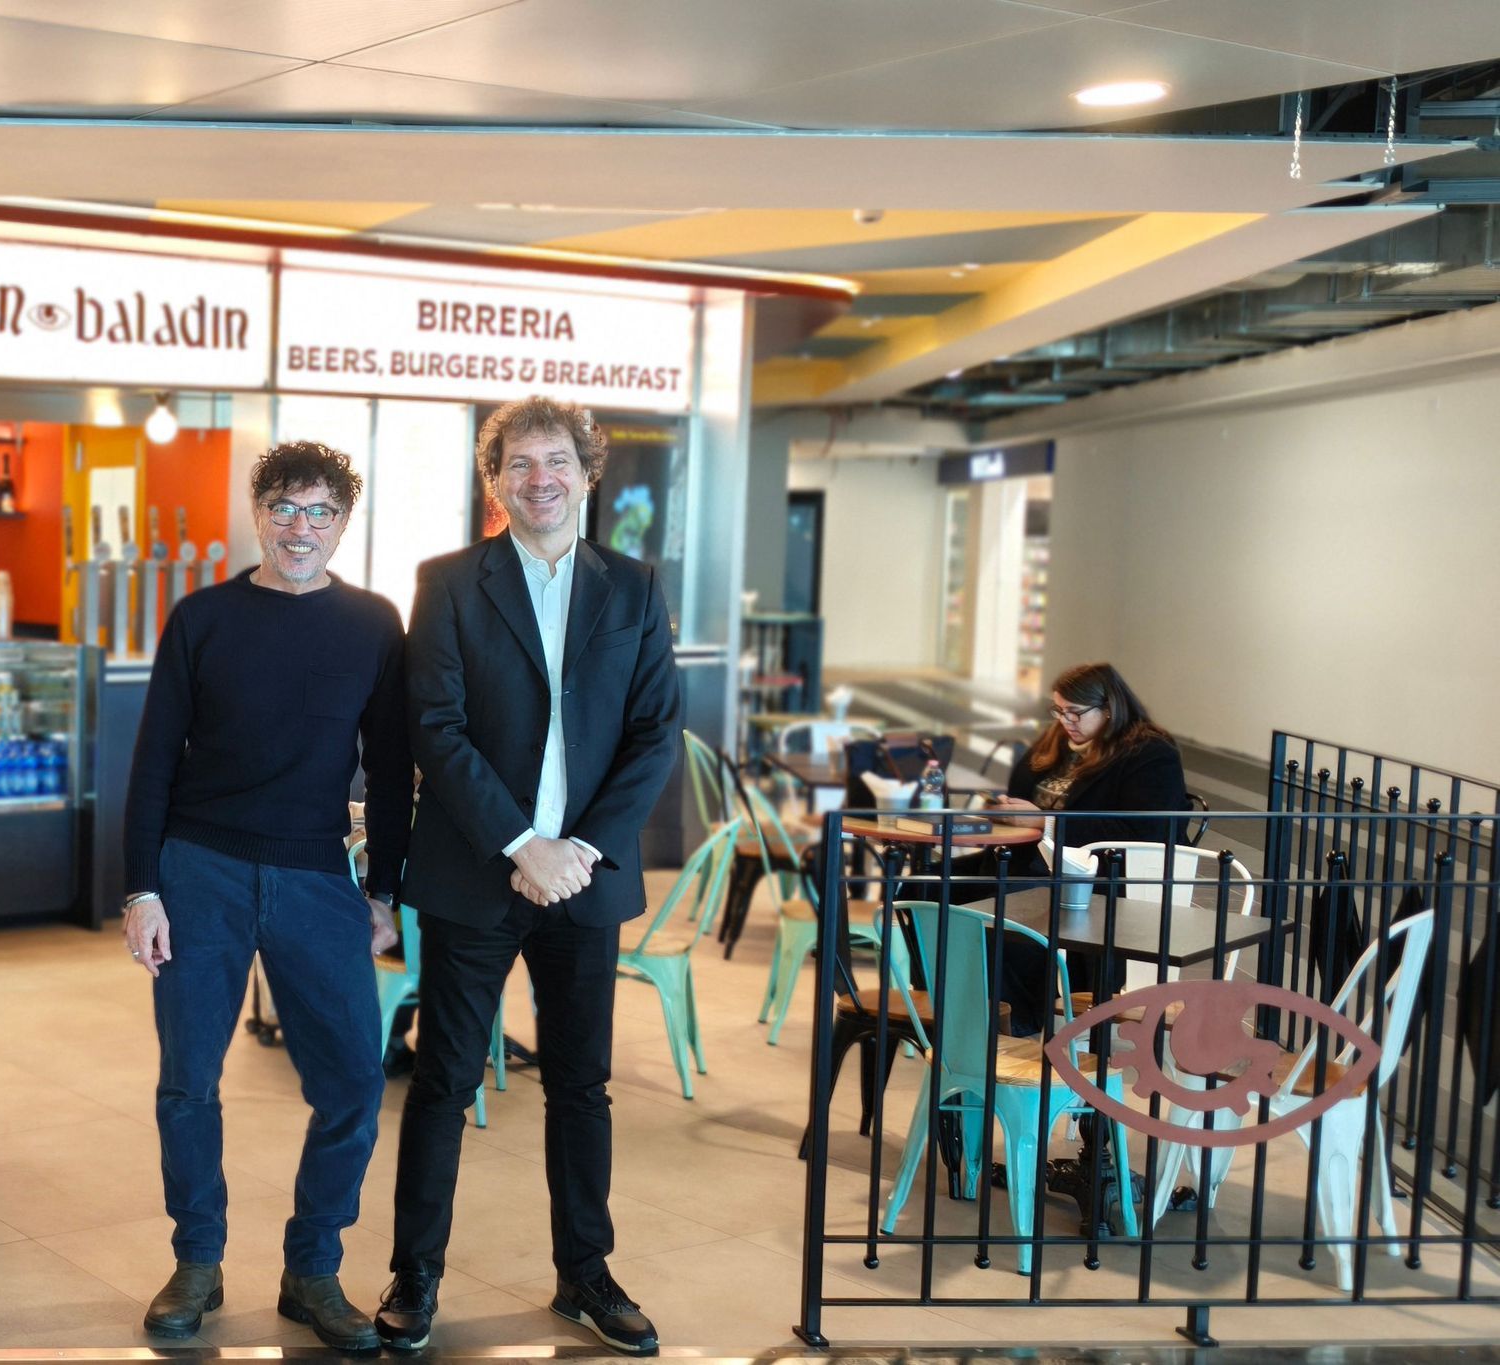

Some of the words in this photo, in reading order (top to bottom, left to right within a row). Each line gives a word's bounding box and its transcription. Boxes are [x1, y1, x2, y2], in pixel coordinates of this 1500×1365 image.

[75, 287, 249, 350] baladin
[418, 299, 574, 341] BIRRERIA
[288, 345, 383, 375] BEERS,
[390, 351, 514, 382] BURGERS
[519, 359, 536, 383] &
[543, 360, 680, 391] BREAKFAST
